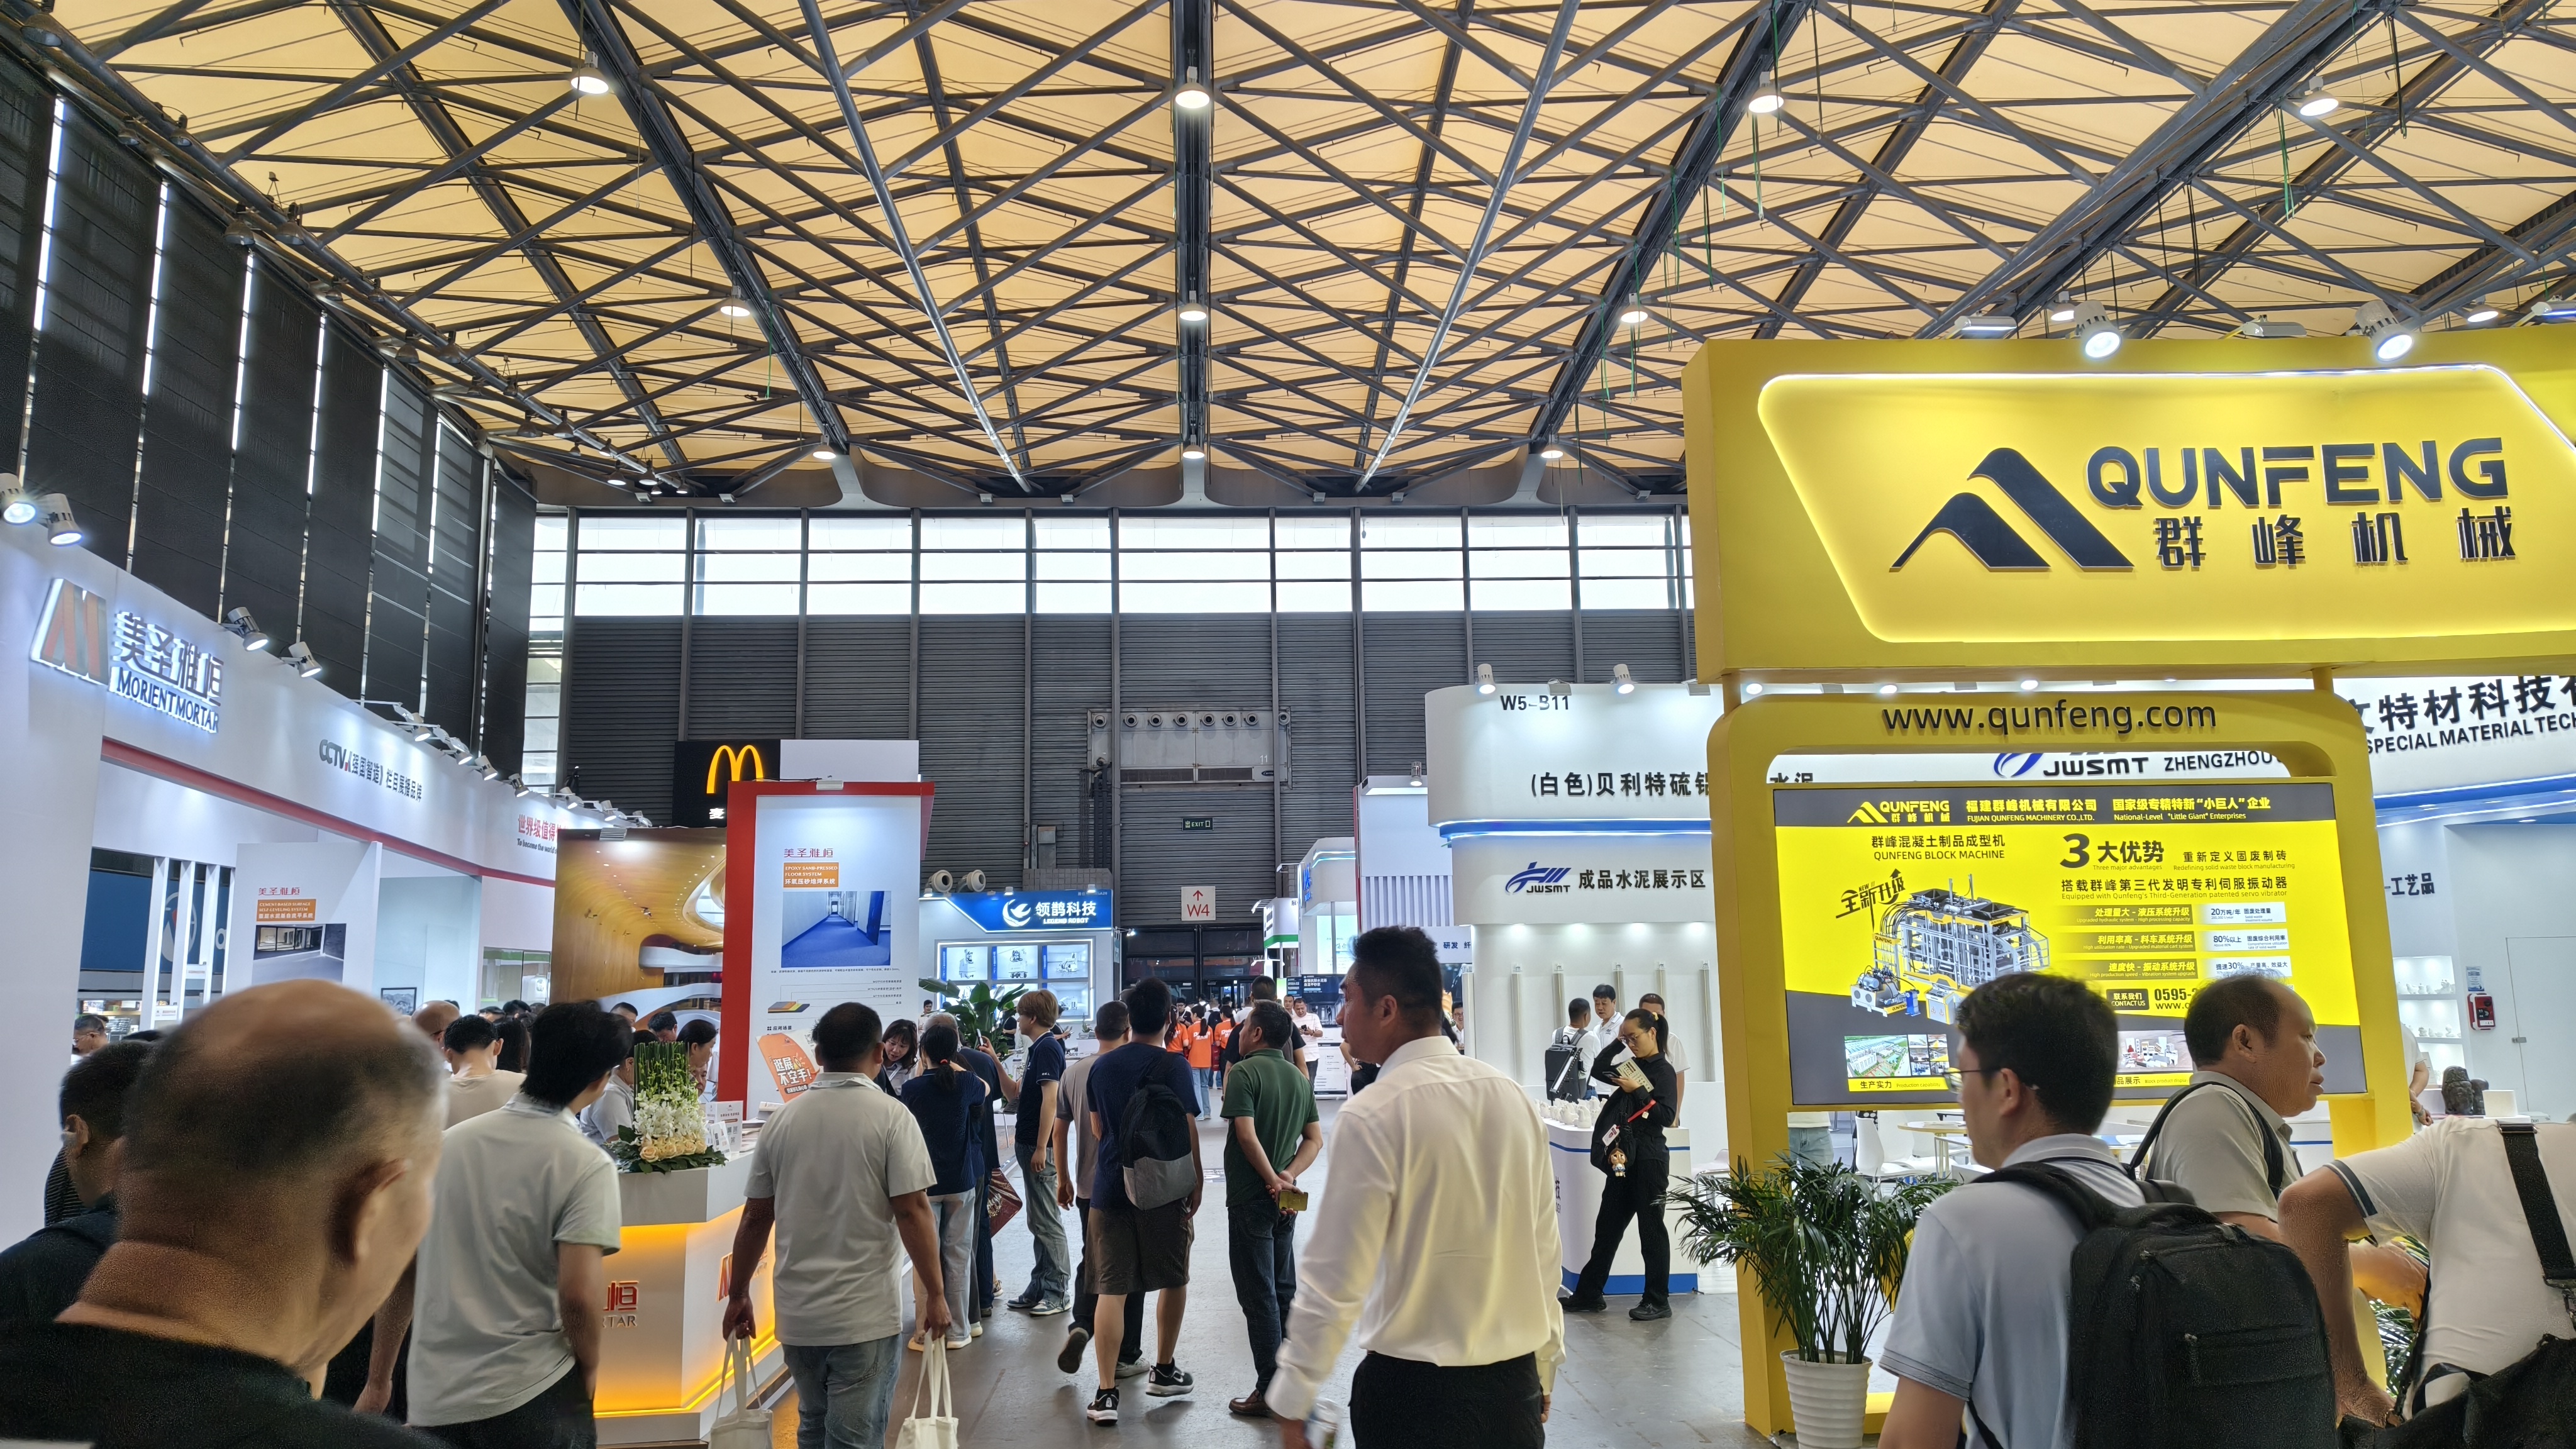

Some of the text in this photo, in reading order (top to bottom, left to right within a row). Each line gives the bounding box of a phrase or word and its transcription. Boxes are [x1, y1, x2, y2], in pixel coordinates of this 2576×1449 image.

[2087, 437, 2508, 509] QUNFENG
[2154, 506, 2516, 570] 群峰机械
[1501, 695, 1568, 710] W5-B11
[1882, 699, 2216, 735] www.qunfeng.com
[2367, 732, 2437, 754] SPECIAL
[2440, 719, 2533, 746] MATERIAL
[2043, 757, 2148, 777] JWSMT
[1880, 800, 1950, 813] QUNFENG
[1967, 798, 2097, 812] 福建群峰机械有限公司
[1891, 813, 1950, 823] 群峰机械
[1991, 814, 2025, 823] QUNFENG
[2210, 812, 2246, 820] Enterprises
[518, 814, 562, 841] 世界级值得
[1871, 834, 2006, 848] 群峰混凝土制品成型机
[784, 848, 833, 858] 美圣雅恒
[1874, 850, 2005, 860] QUNFENG BLOCK MACHINE
[2183, 850, 2287, 862] 重新定义固废制砖
[2254, 862, 2295, 870] manufacturing
[1579, 869, 1706, 889] 成品水泥展示区
[2061, 876, 2287, 892] 搭载群峰第三代发明专利伺服振动器
[1526, 885, 1570, 893] JWSMT
[1858, 883, 1870, 892] NEW
[1035, 901, 1097, 917] 领鹊科技
[1187, 904, 1210, 917] W4
[2095, 907, 2189, 917] 处理量大 液压系统升级
[1875, 935, 1892, 944] QUNFENG
[2097, 934, 2192, 944] 利用率高 料车系统升级
[2109, 962, 2195, 972] 速度快 振动系统升级
[1860, 1080, 1892, 1089] 生产实力
[2114, 1076, 2141, 1085] 品展示
